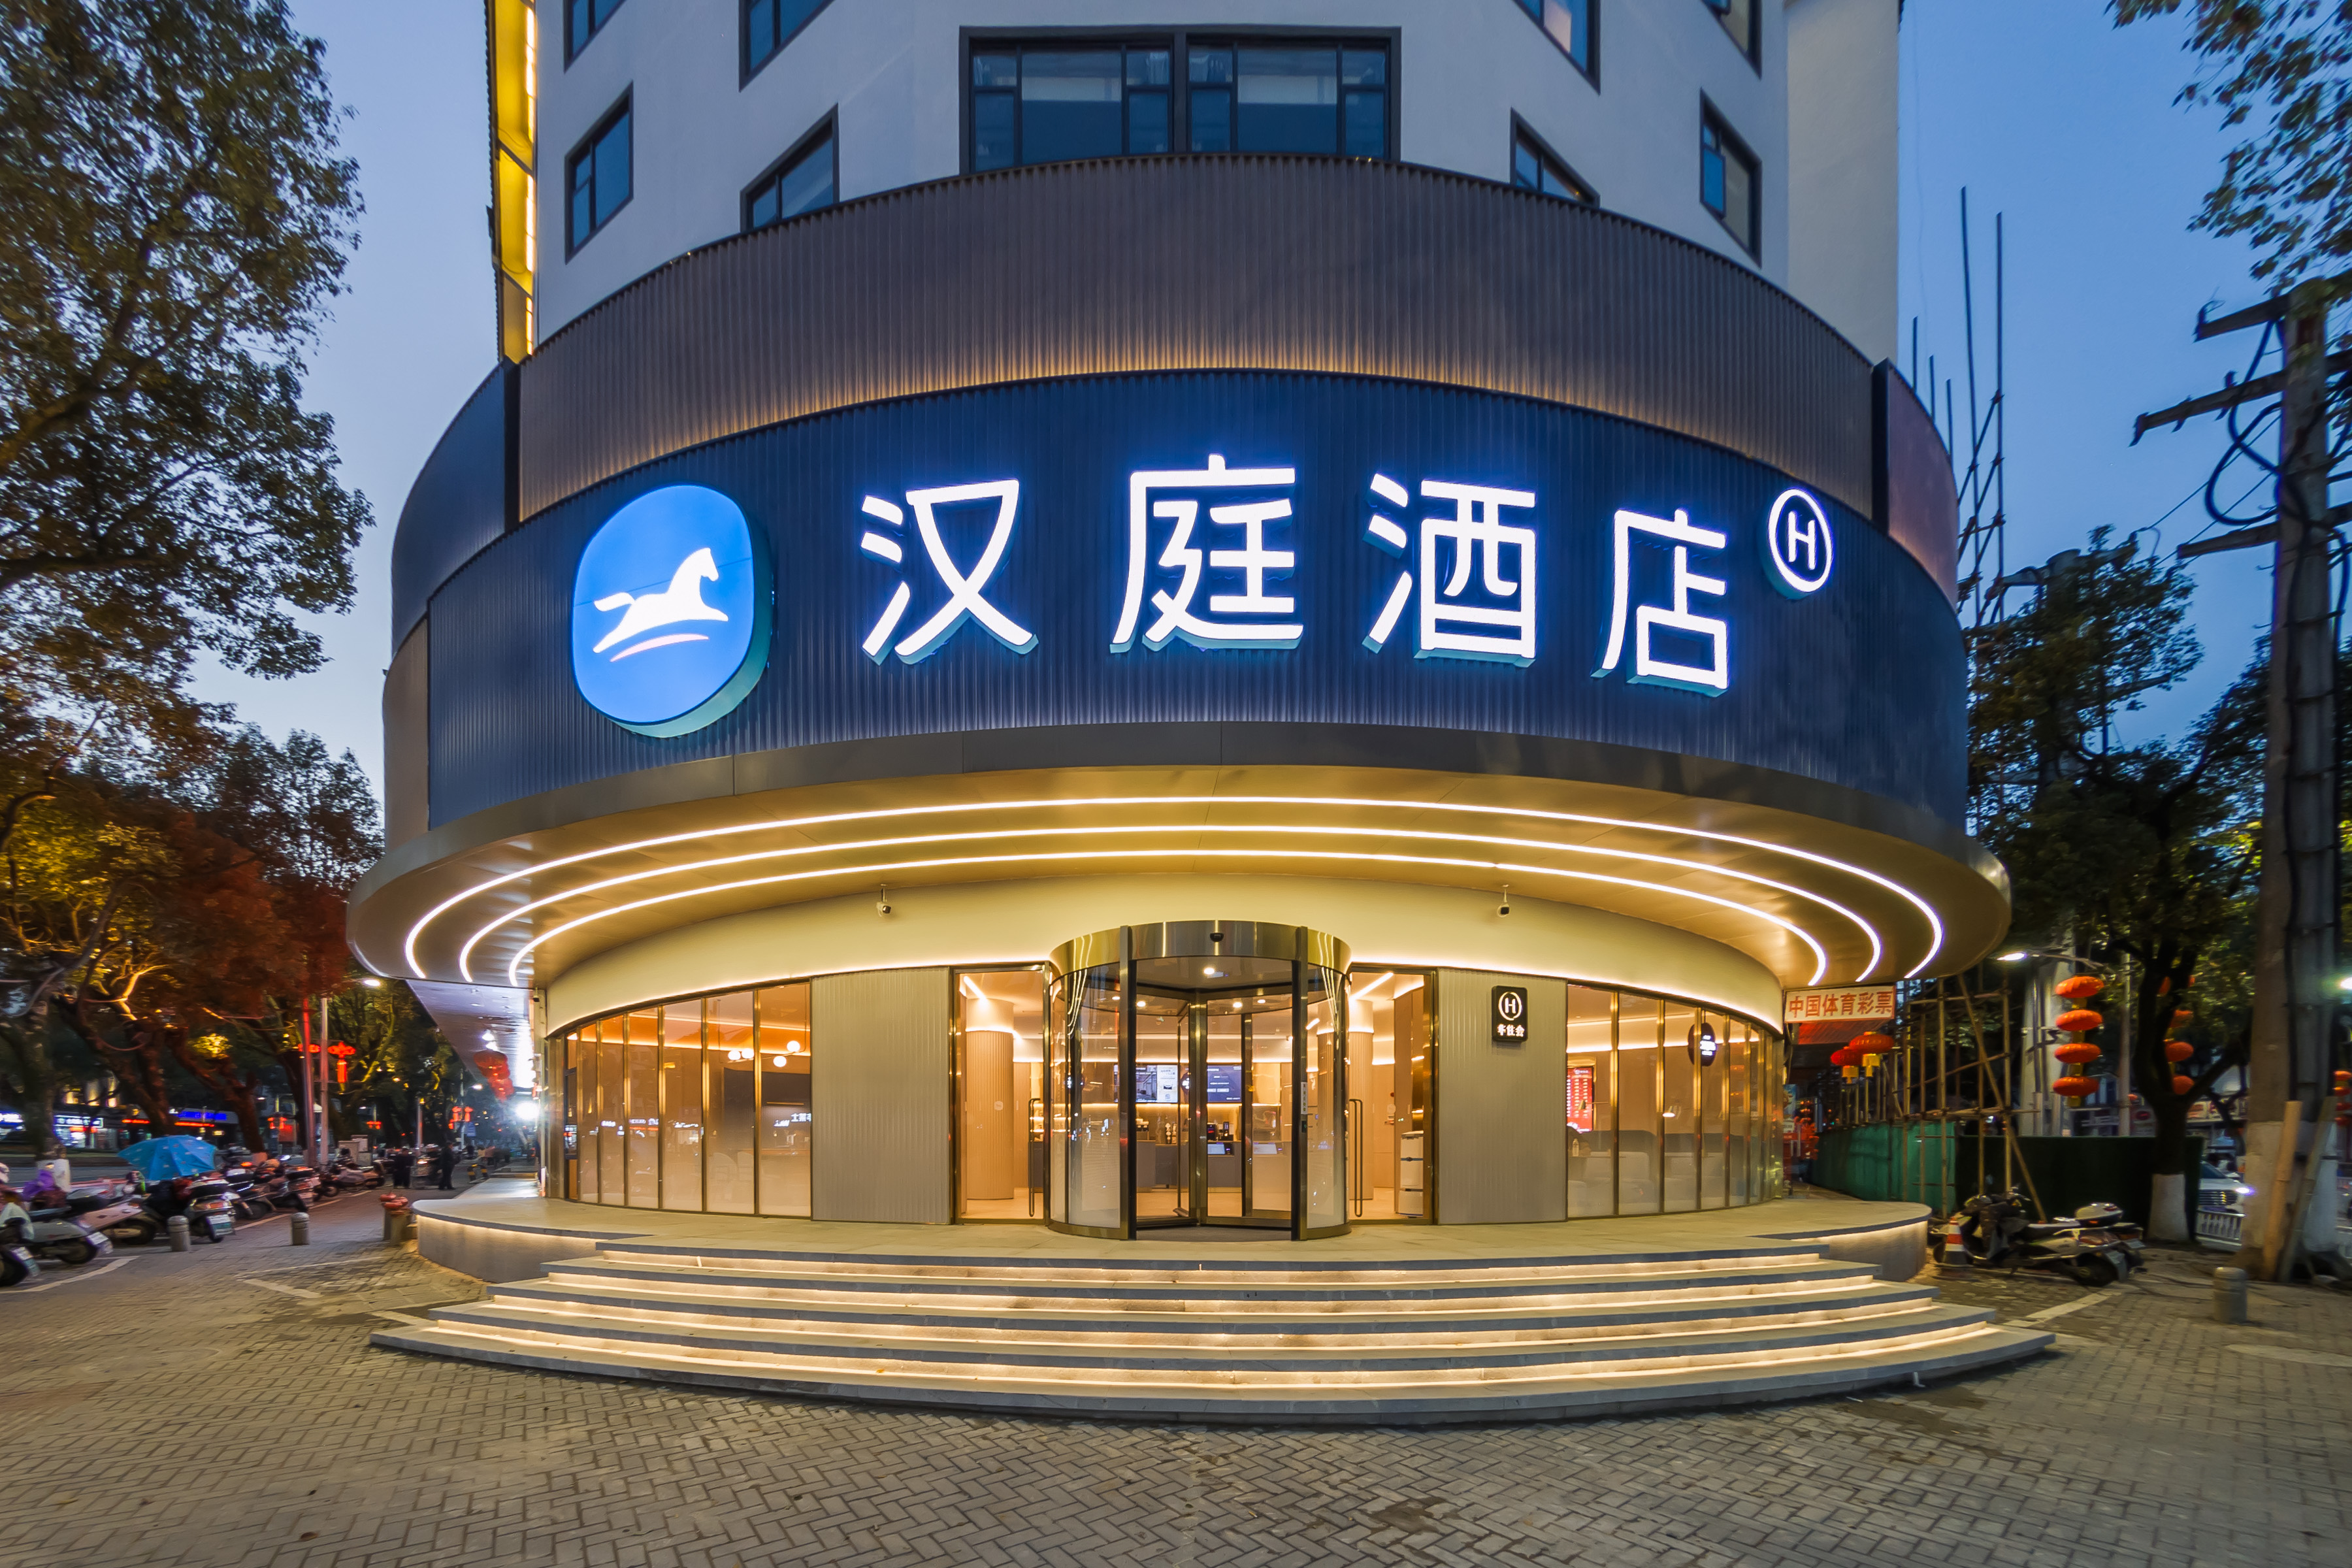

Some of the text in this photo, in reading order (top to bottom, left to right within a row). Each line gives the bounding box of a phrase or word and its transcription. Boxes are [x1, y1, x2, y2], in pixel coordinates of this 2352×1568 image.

[860, 453, 1727, 690] 汉庭酒店
[1789, 990, 1893, 1018] 中国体育彩票
